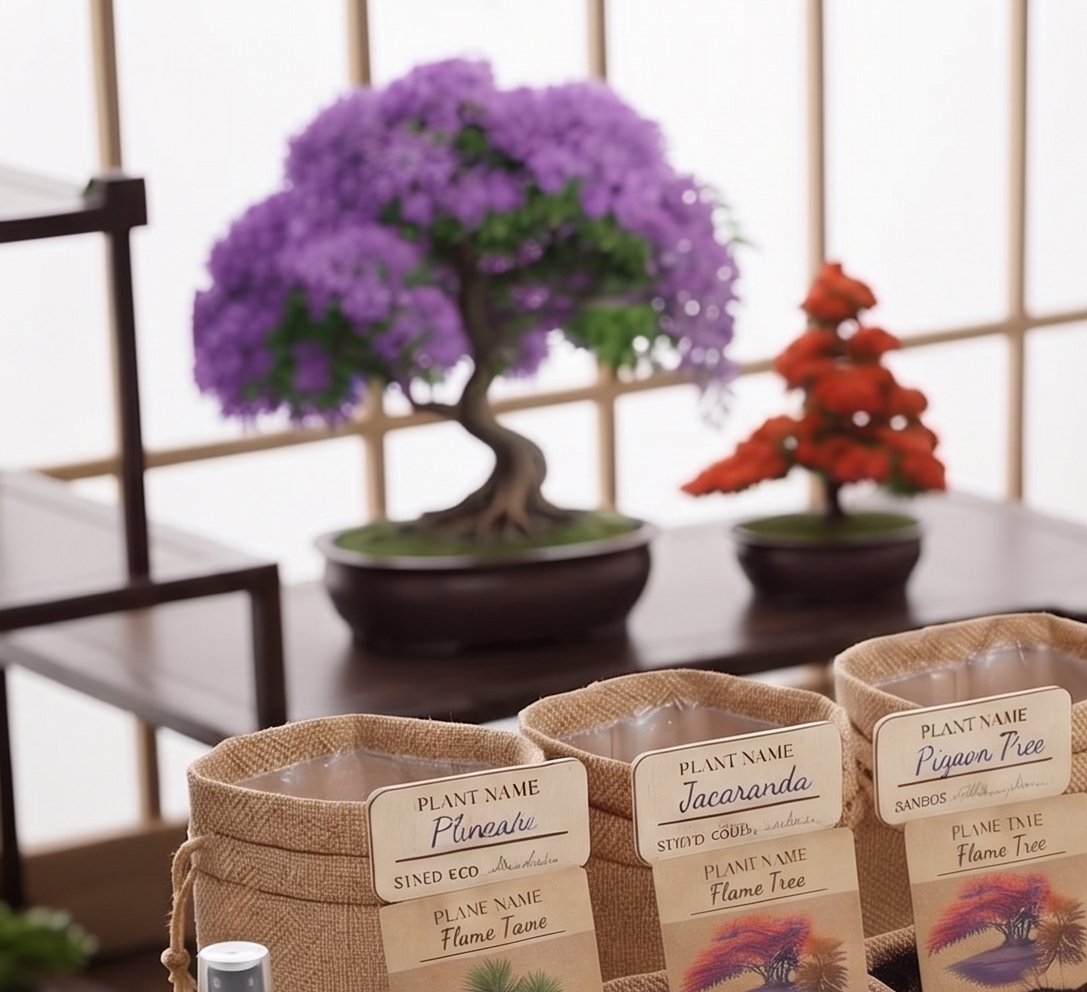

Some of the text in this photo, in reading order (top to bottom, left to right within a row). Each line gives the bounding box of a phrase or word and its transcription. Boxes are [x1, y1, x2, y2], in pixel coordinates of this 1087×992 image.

[921, 708, 1028, 739] PLANT NAME
[679, 744, 794, 776] PLANT NAME
[417, 779, 540, 812] PLANT NAME
[679, 765, 813, 813] Jacaranda
[761, 848, 807, 869] NAME
[957, 833, 1048, 867] Flame Tree
[449, 866, 479, 880] ECO
[710, 871, 806, 905] Flame Tree
[433, 889, 543, 925] PLANE NAME
[441, 926, 496, 951] Flame
